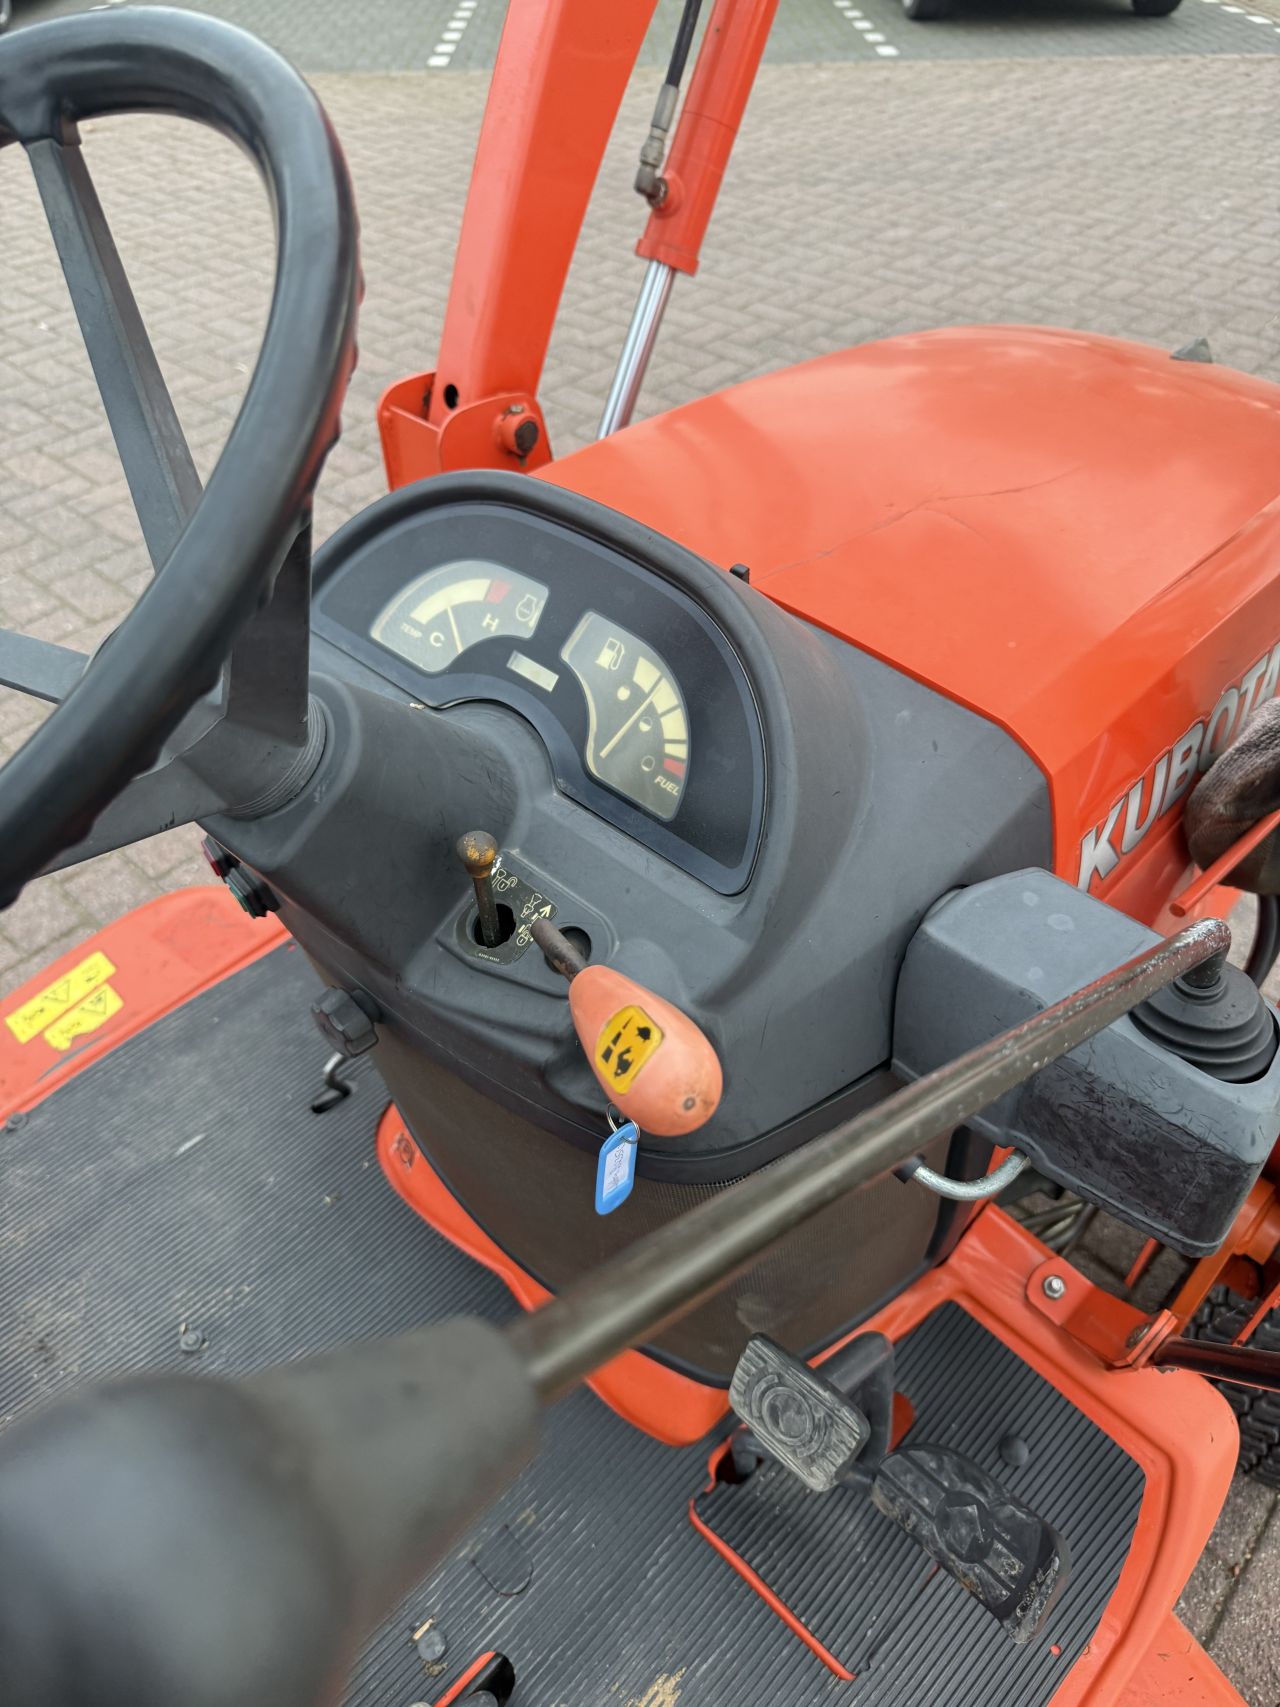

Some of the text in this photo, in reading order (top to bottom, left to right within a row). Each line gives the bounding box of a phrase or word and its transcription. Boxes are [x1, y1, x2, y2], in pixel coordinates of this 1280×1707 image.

[401, 622, 422, 638] TEMP
[482, 613, 499, 632] H
[429, 631, 445, 647] C
[654, 775, 680, 796] FUEL
